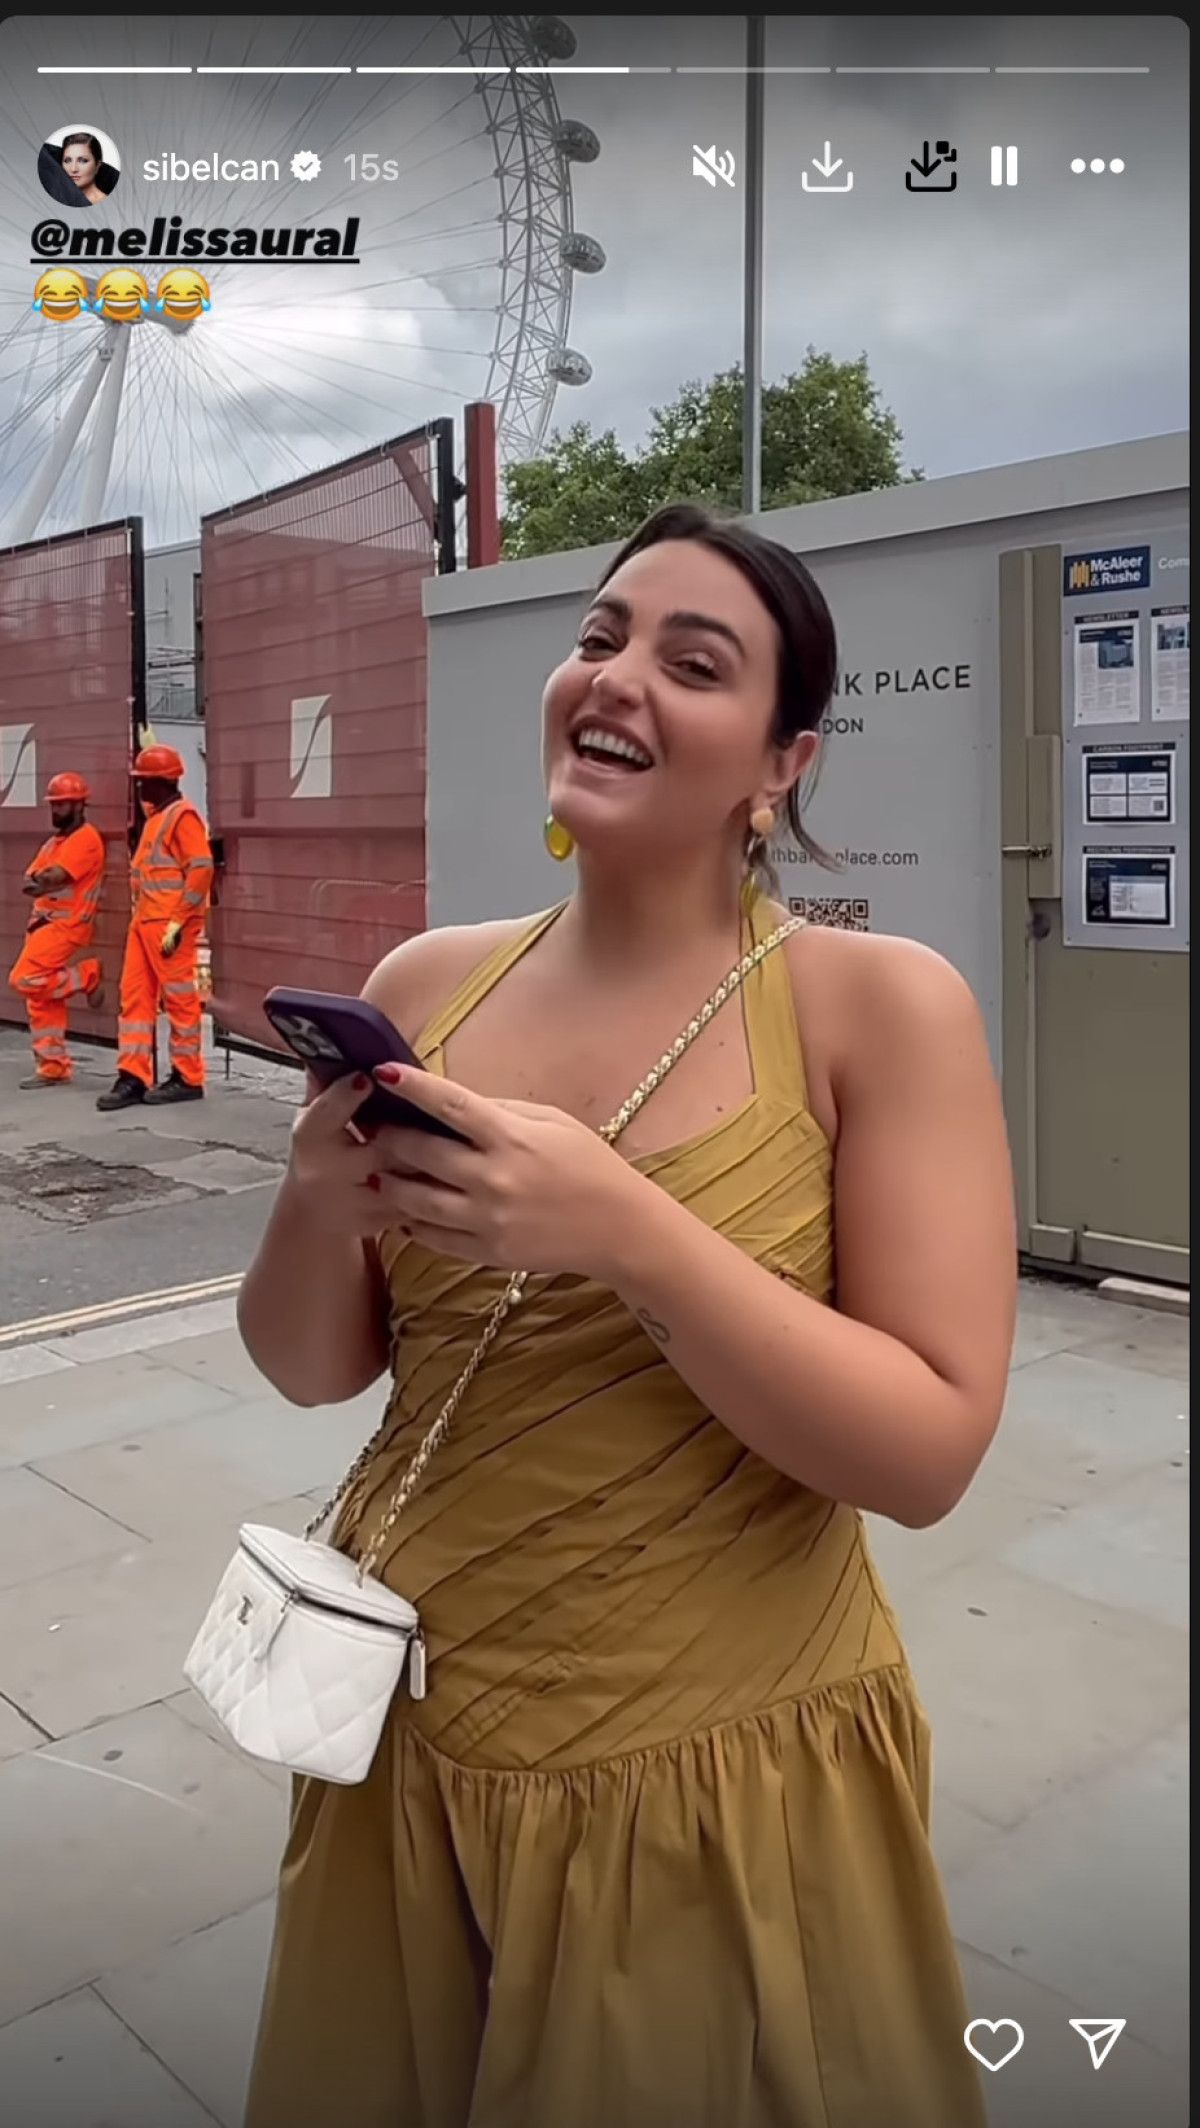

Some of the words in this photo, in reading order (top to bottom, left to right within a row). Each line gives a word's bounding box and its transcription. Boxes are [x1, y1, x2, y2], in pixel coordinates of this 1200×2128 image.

[1090, 556, 1143, 572] McAleer
[1091, 574, 1100, 586] &
[1102, 570, 1141, 584] Rushe
[875, 665, 971, 694] PLACE
